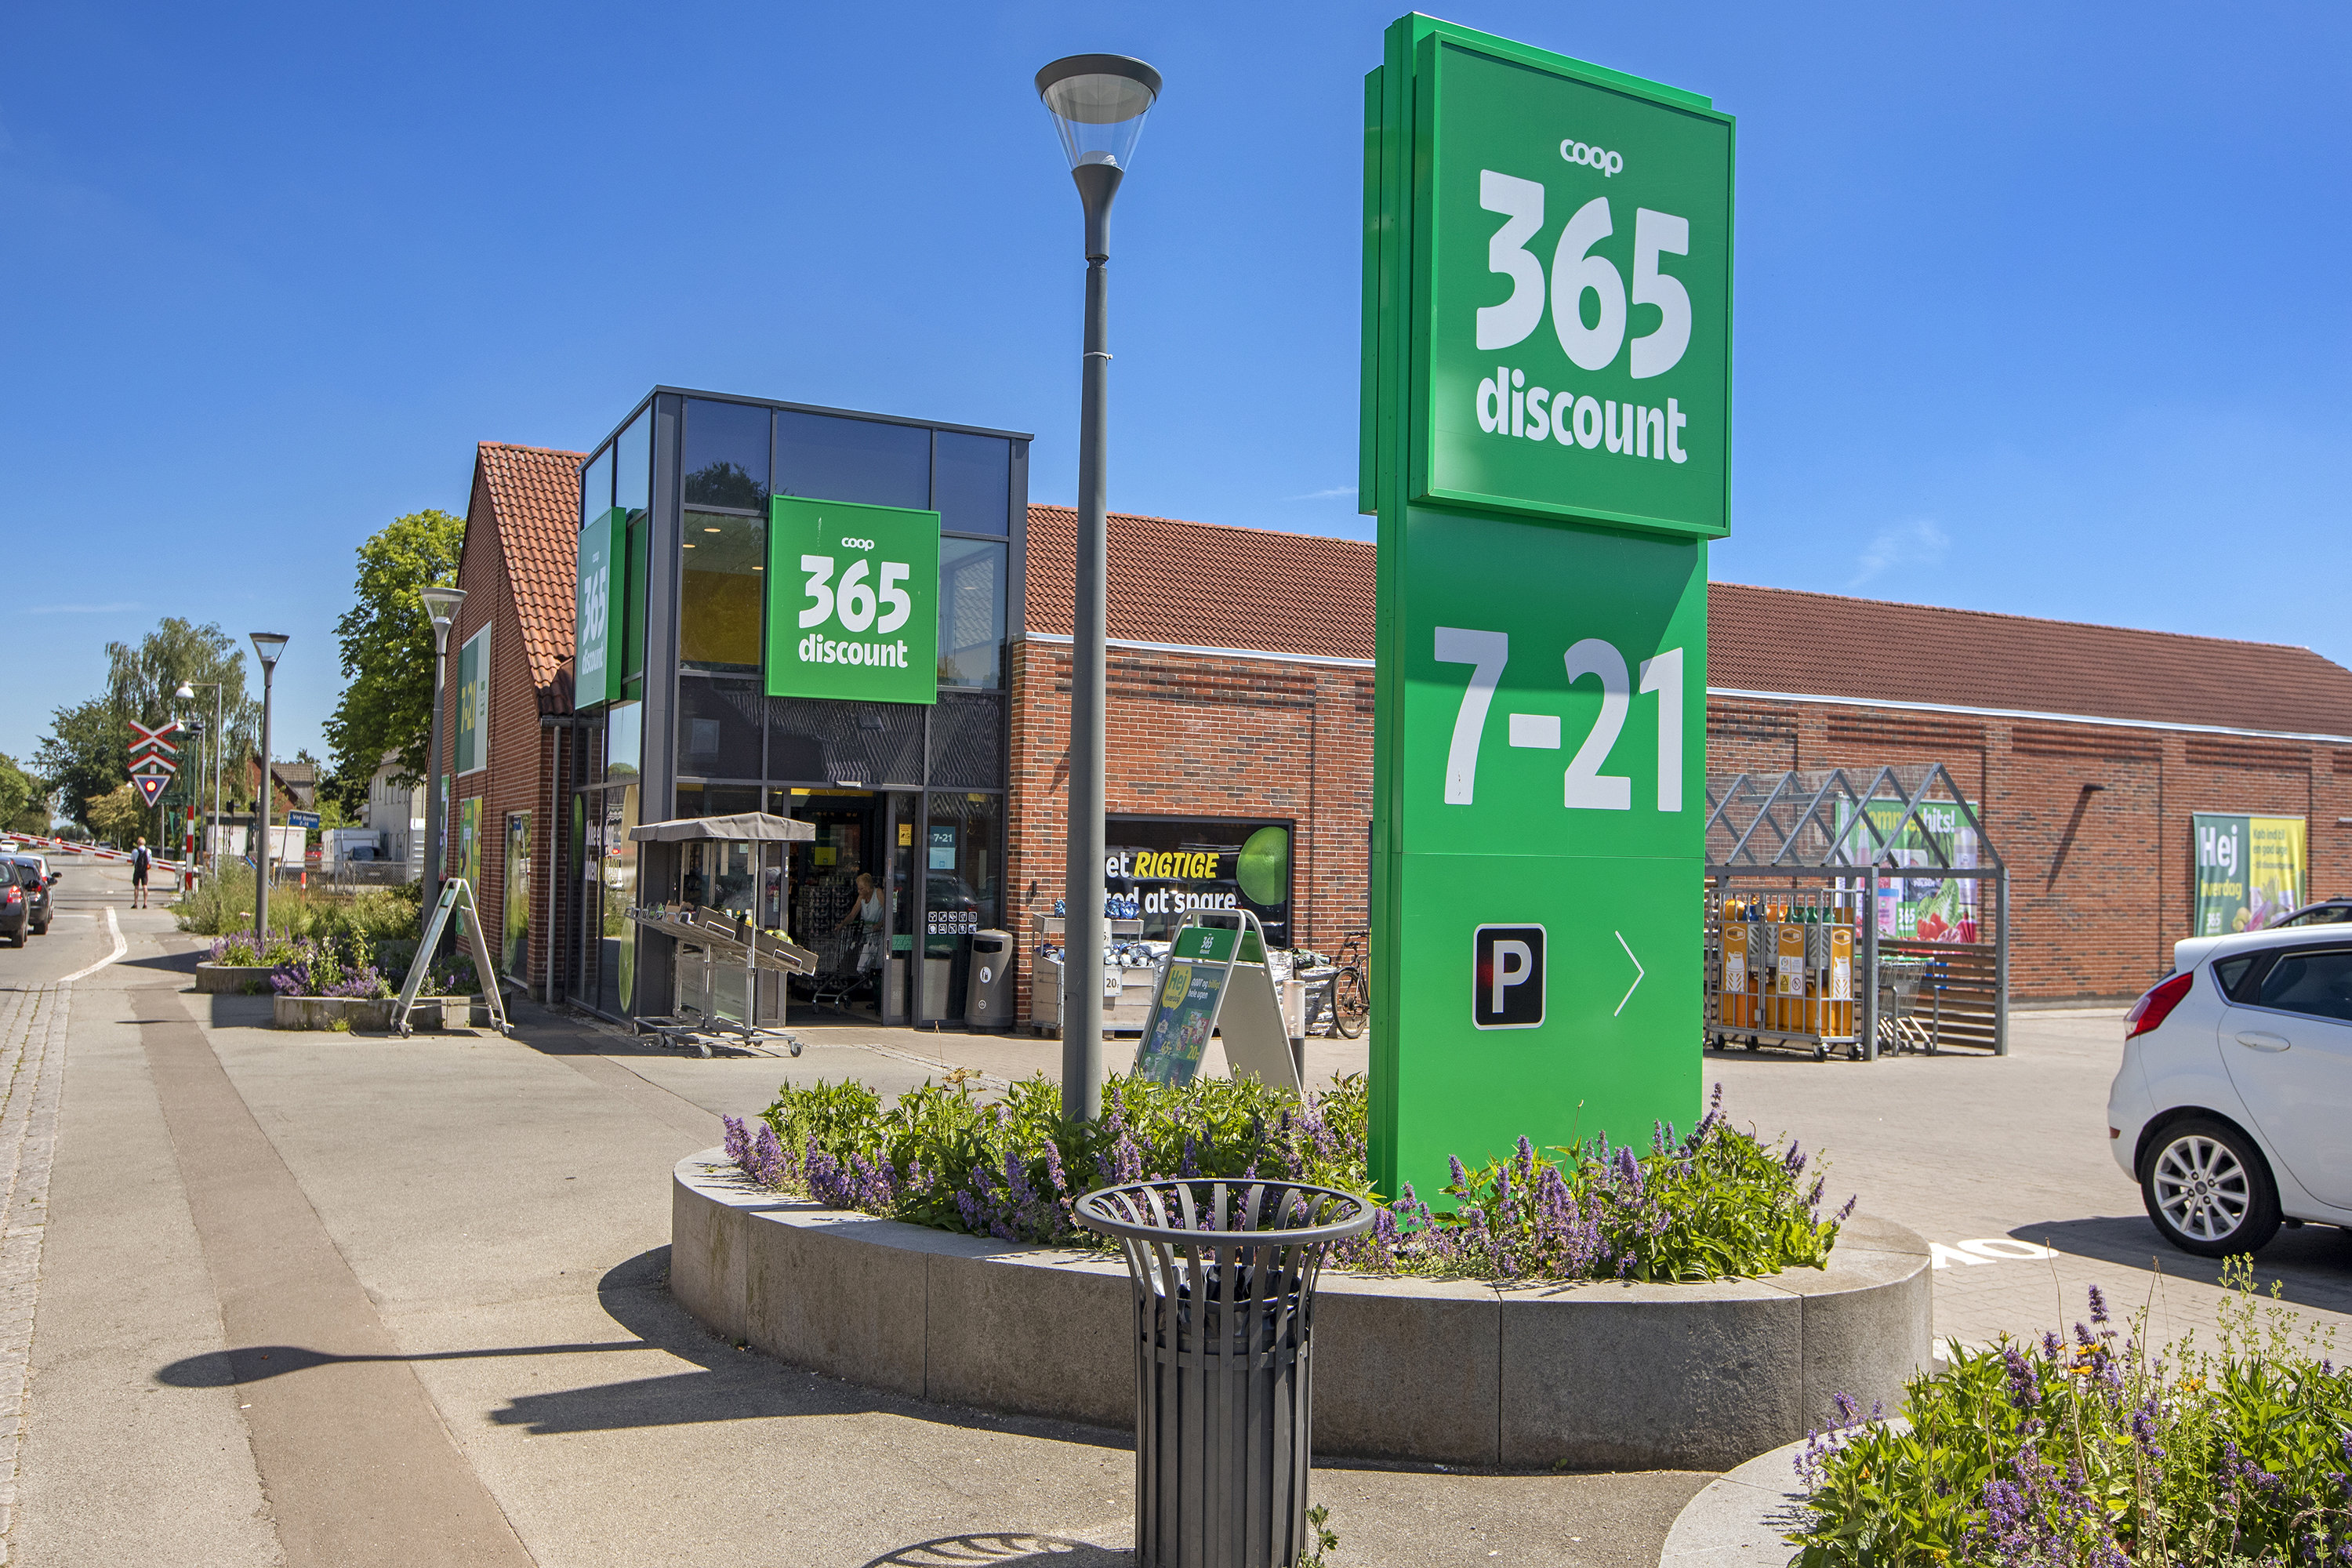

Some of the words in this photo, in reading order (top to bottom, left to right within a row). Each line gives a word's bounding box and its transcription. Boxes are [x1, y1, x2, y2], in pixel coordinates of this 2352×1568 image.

[1560, 139, 1623, 177] coop
[1476, 169, 1692, 379] 365
[1476, 366, 1687, 463] discount
[841, 537, 874, 551] coop
[583, 565, 606, 646] 365
[799, 554, 911, 634] 365
[583, 641, 604, 675] discount
[798, 633, 909, 668] discount
[1435, 626, 1683, 811] 7-21
[933, 833, 953, 843] 7-21
[2200, 824, 2238, 877] Hej
[1106, 851, 1130, 878] et
[1134, 851, 1220, 879] RIGTIGE
[1145, 887, 1169, 913] at
[1898, 908, 1916, 924] 365
[1200, 937, 1214, 949] 365
[1167, 970, 1189, 996] Hej
[1188, 989, 1196, 997] hele
[1202, 980, 1208, 989] og
[1492, 940, 1532, 1013] P
